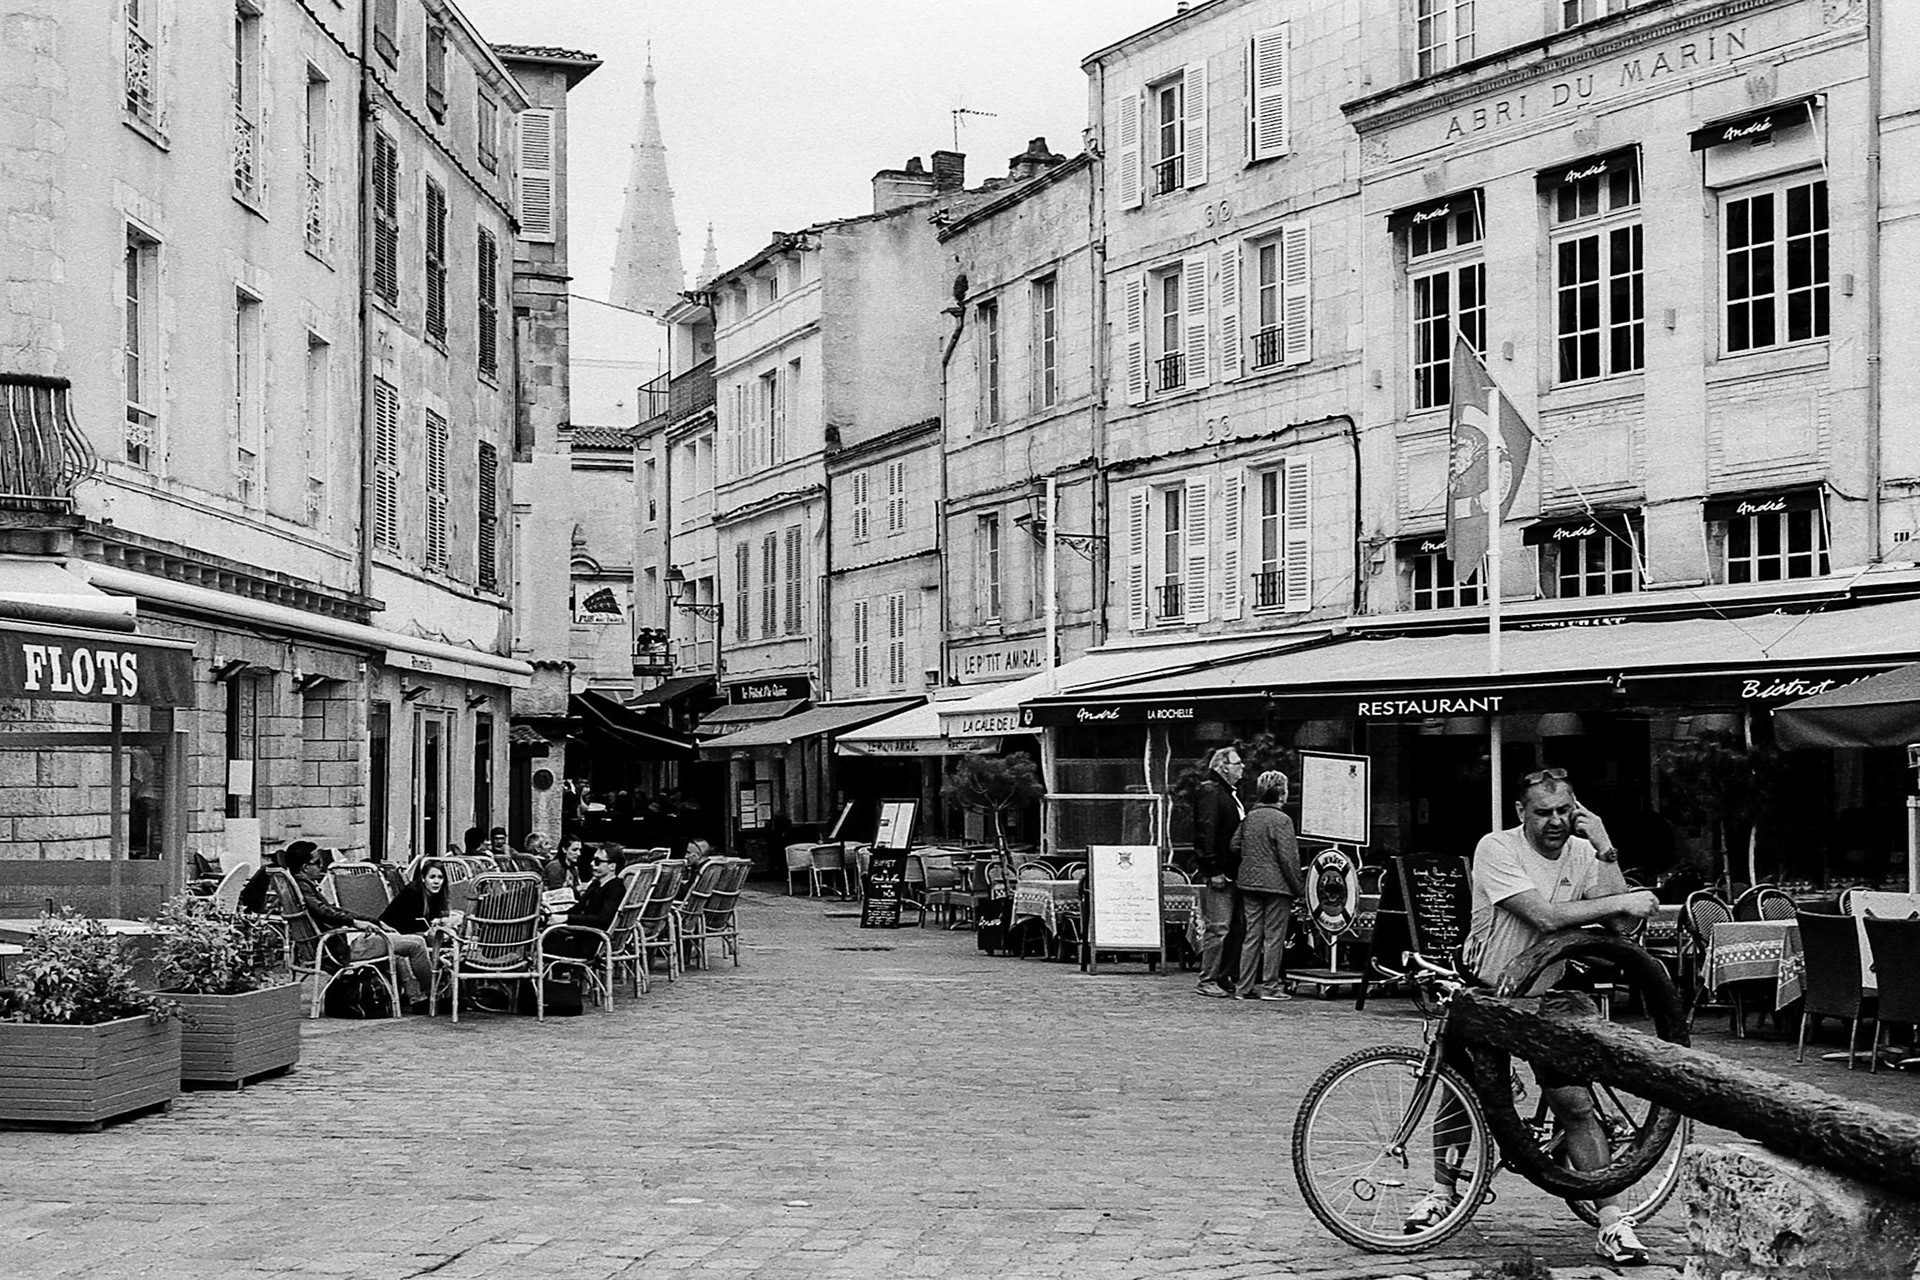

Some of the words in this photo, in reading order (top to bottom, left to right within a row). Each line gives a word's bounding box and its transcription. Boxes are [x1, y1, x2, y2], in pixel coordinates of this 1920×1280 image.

[1446, 95, 1526, 140] ABRI
[1552, 75, 1594, 107] DU
[1620, 28, 1746, 87] MARIN
[1723, 117, 1773, 141] André
[1564, 161, 1608, 184] André
[1412, 203, 1450, 223] André
[1736, 497, 1788, 515] André
[1552, 523, 1597, 541] André
[22, 643, 138, 698] FLOTS
[965, 656, 975, 674] LE
[1005, 648, 1041, 671] AMIRAL
[1741, 678, 1836, 699] Bistrot
[1077, 706, 1120, 722] André
[1147, 710, 1156, 719] LA
[1157, 707, 1194, 719] ROCHELLE
[1358, 696, 1503, 716] RESTAURANT
[963, 720, 972, 732] LA
[974, 718, 995, 732] CALE
[997, 717, 1008, 731] DE
